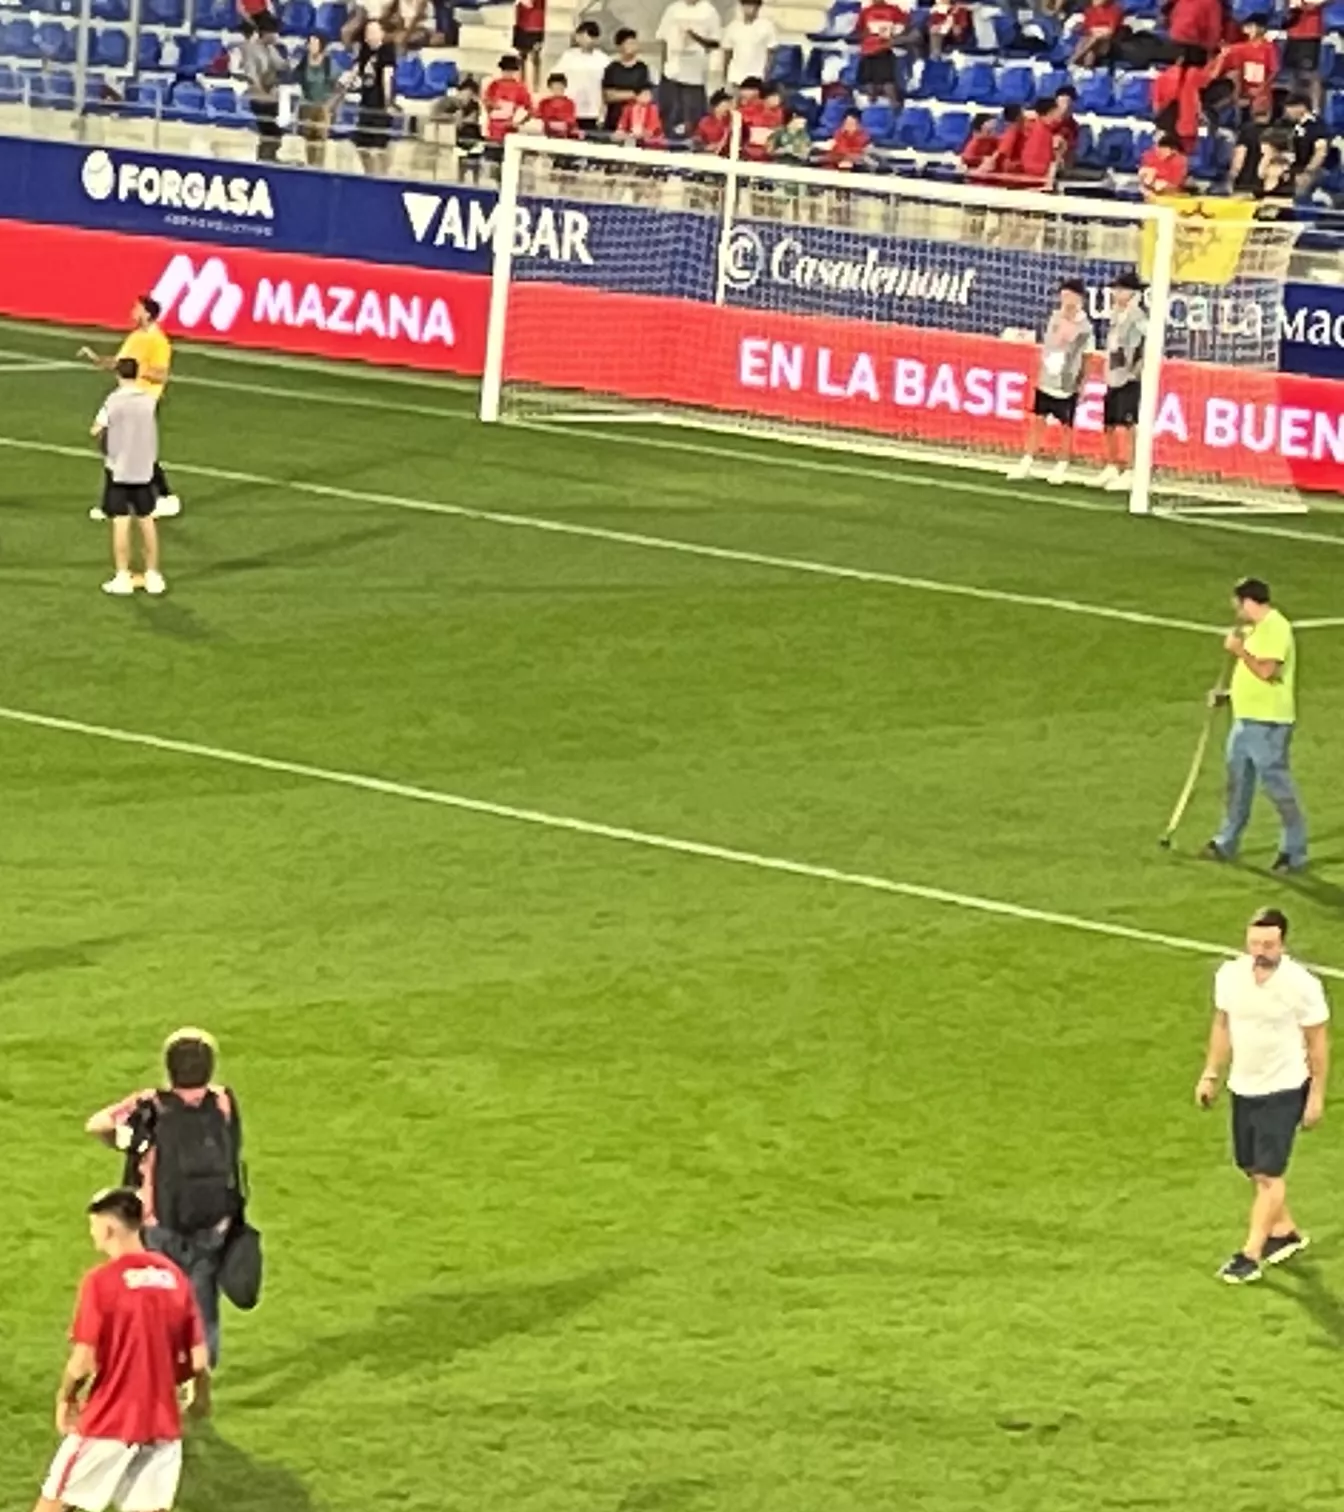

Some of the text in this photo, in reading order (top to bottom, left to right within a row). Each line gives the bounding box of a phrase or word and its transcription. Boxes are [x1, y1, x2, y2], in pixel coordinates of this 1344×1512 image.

[118, 163, 274, 220] FORGASA
[433, 195, 595, 265] AMBAR
[252, 277, 456, 347] MAZANA
[739, 336, 804, 391] EN
[816, 346, 881, 402] LA
[893, 356, 1029, 420] BASE
